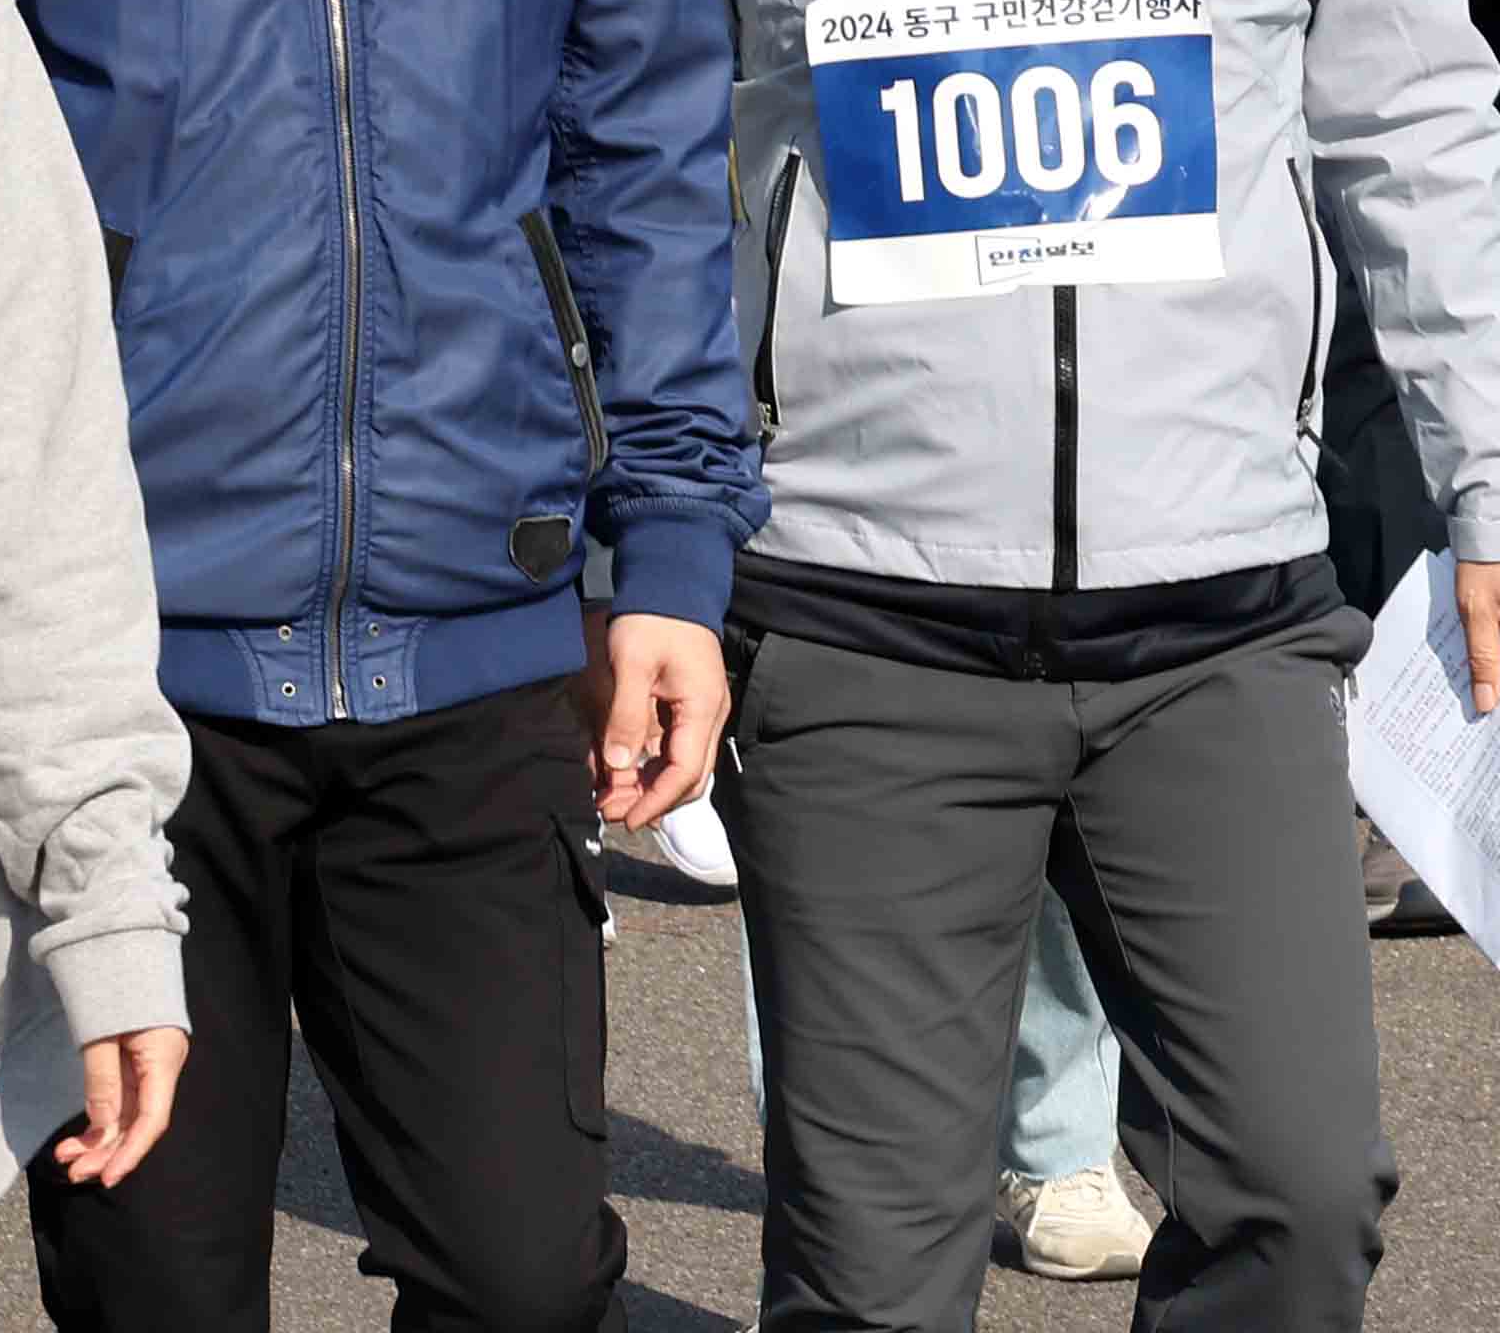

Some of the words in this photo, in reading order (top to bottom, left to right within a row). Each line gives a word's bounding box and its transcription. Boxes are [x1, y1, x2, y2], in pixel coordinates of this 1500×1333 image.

[821, 12, 894, 44] 2024
[903, 5, 960, 39] 동구
[880, 60, 1164, 203] 1006
